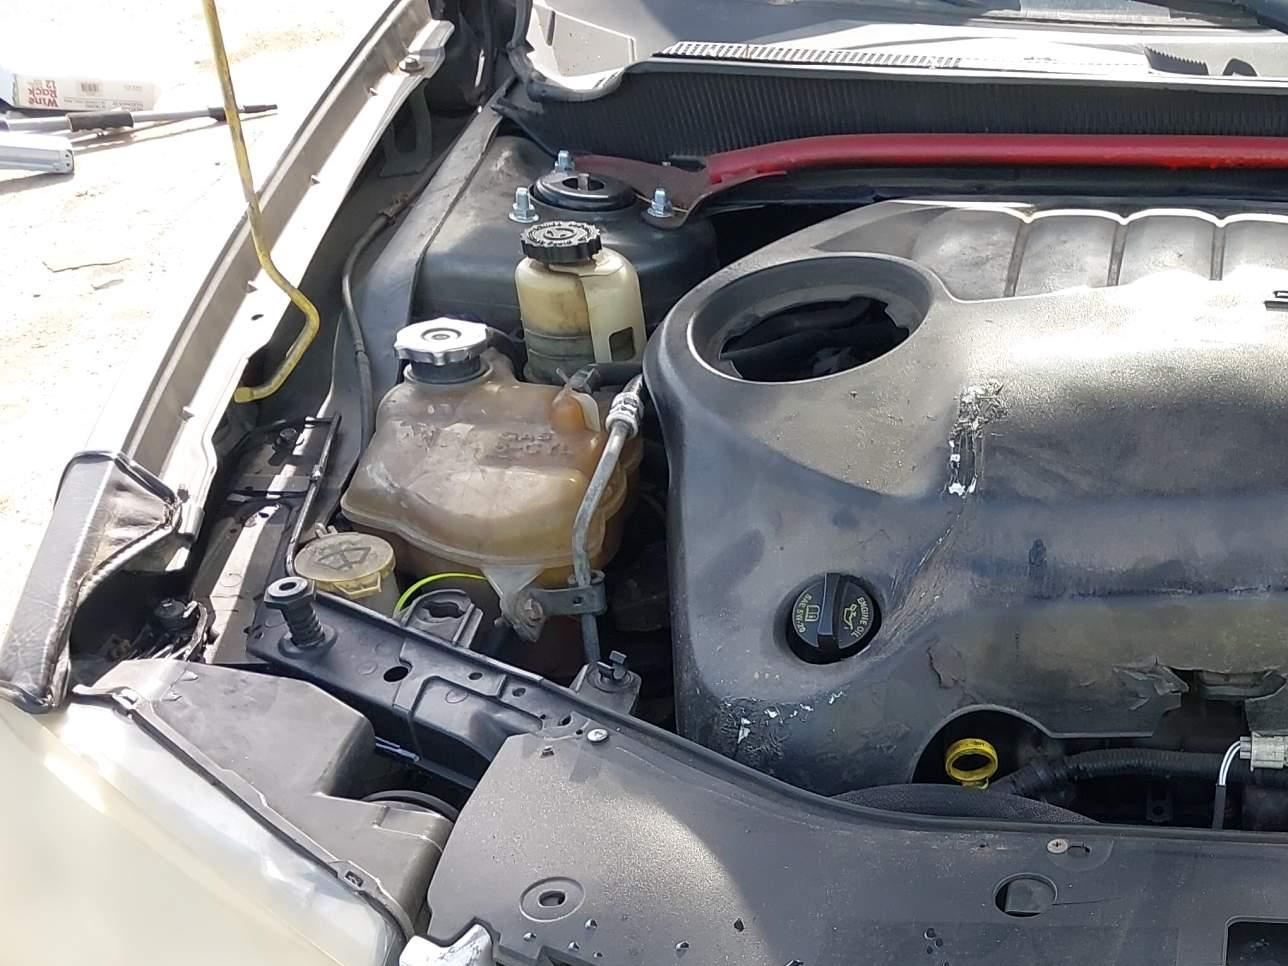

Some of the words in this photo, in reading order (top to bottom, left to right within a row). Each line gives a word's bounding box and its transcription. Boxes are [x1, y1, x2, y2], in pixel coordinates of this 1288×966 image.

[27, 88, 57, 99] Rack
[28, 97, 59, 108] Wine
[799, 594, 812, 608] SAE
[857, 597, 869, 625] ENGINE
[851, 626, 865, 638] OIL
